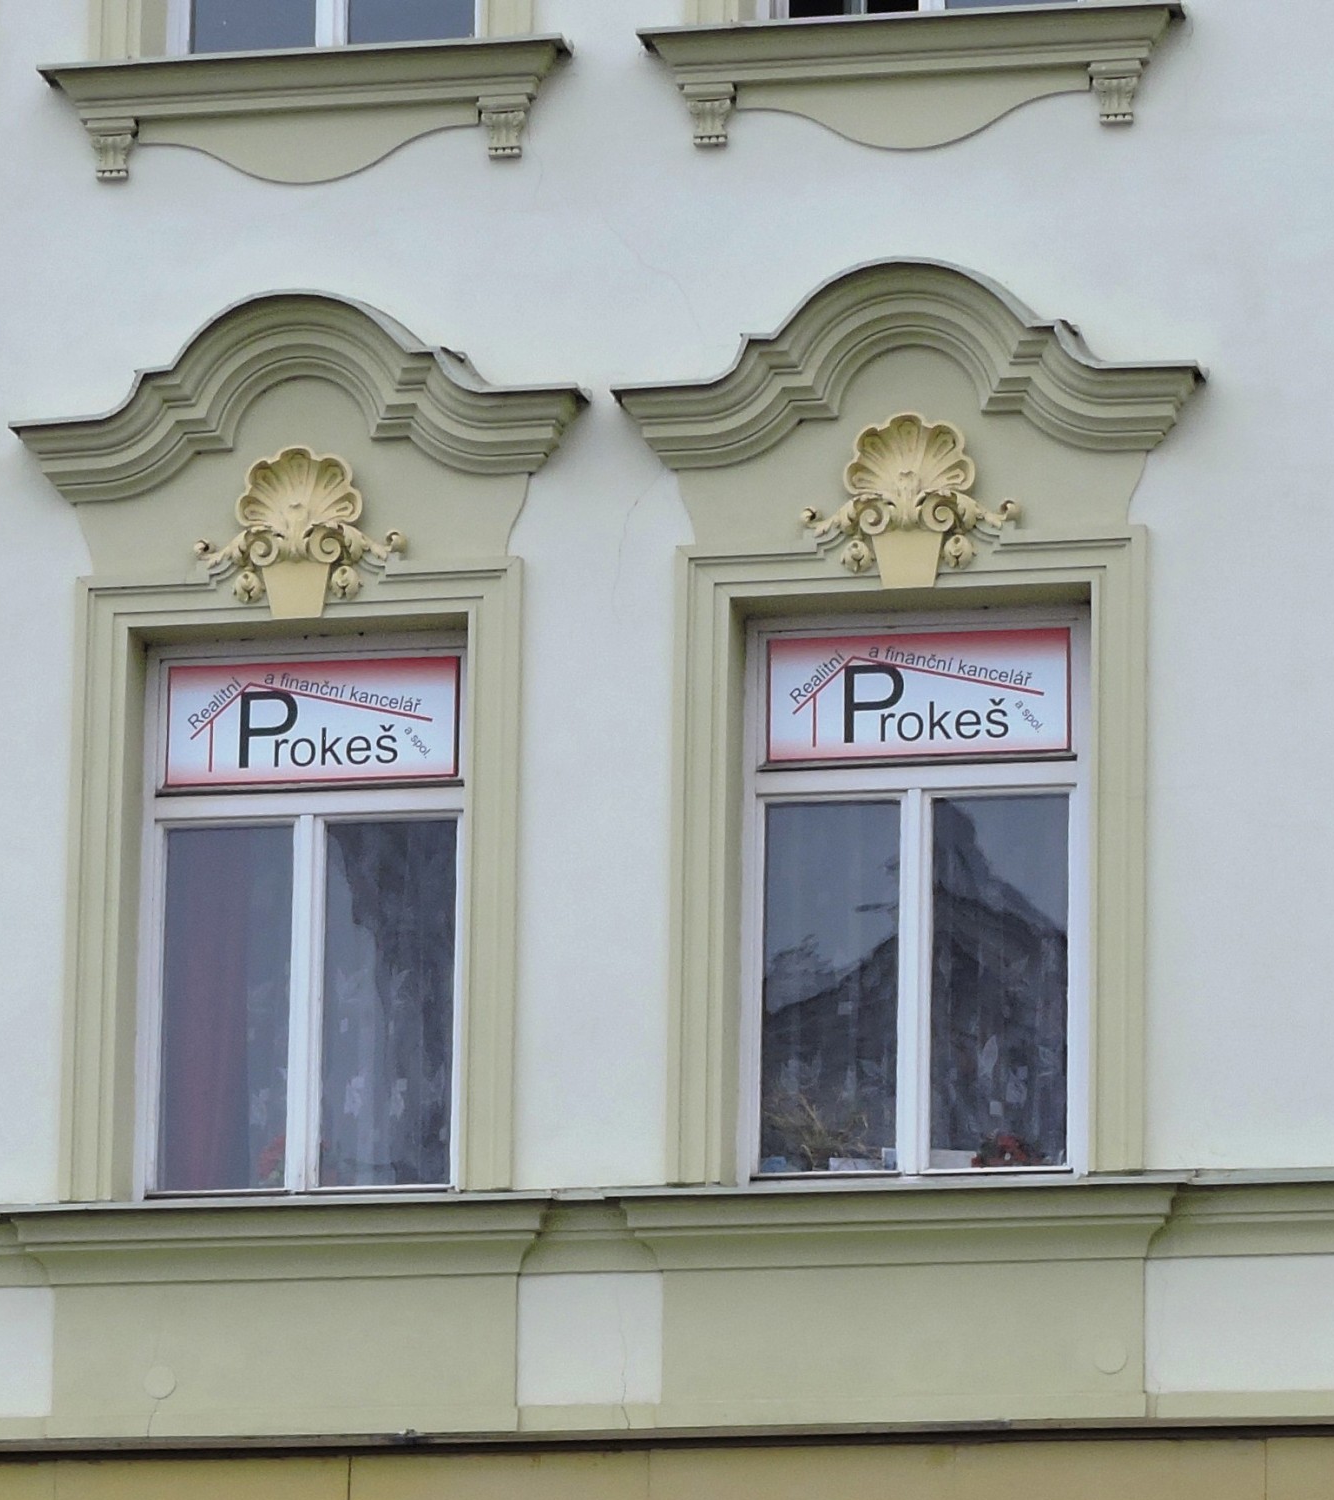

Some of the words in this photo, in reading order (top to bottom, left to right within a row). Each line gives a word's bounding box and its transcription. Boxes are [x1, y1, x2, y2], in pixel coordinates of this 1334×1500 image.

[188, 677, 241, 730] Realitní
[264, 672, 275, 685] a
[280, 672, 346, 698] finanční
[350, 686, 422, 713] kancelář
[789, 650, 845, 704] Realitní
[868, 646, 879, 658] a
[885, 645, 953, 672] finanční
[957, 659, 1033, 687] kancelář
[238, 690, 398, 769] Prokeš
[843, 664, 1009, 744] Prokeš
[1015, 699, 1024, 709] a
[1022, 708, 1042, 733] spol.
[404, 726, 412, 735] a
[411, 734, 431, 758] spol.
